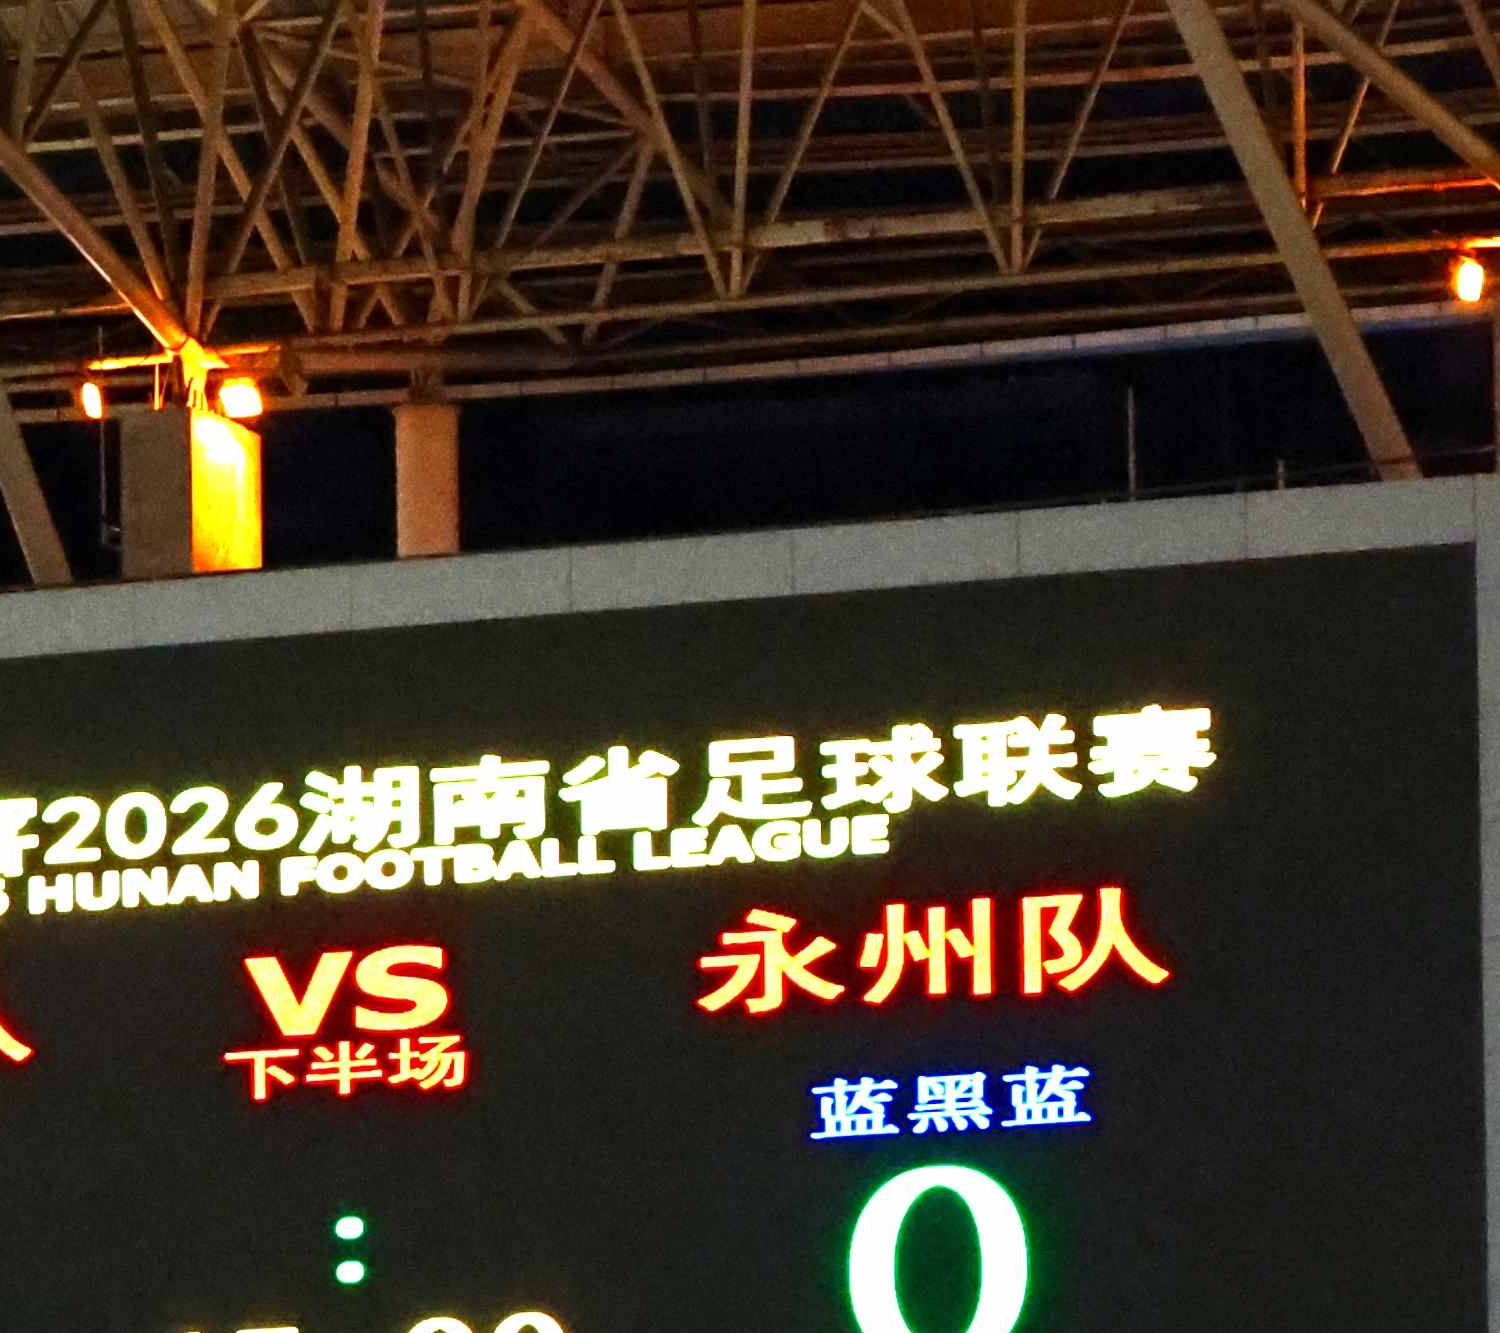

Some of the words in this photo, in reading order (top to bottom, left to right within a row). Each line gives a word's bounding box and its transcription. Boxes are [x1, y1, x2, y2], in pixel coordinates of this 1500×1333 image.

[28, 858, 260, 915] HUNAN
[280, 834, 616, 896] FOOTBALL
[633, 814, 890, 871] LEAGUE
[243, 945, 451, 1038] VS
[697, 886, 1171, 1014] 永州队
[224, 1033, 468, 1102] 下半场
[810, 1063, 1093, 1140] 蓝黑蓝
